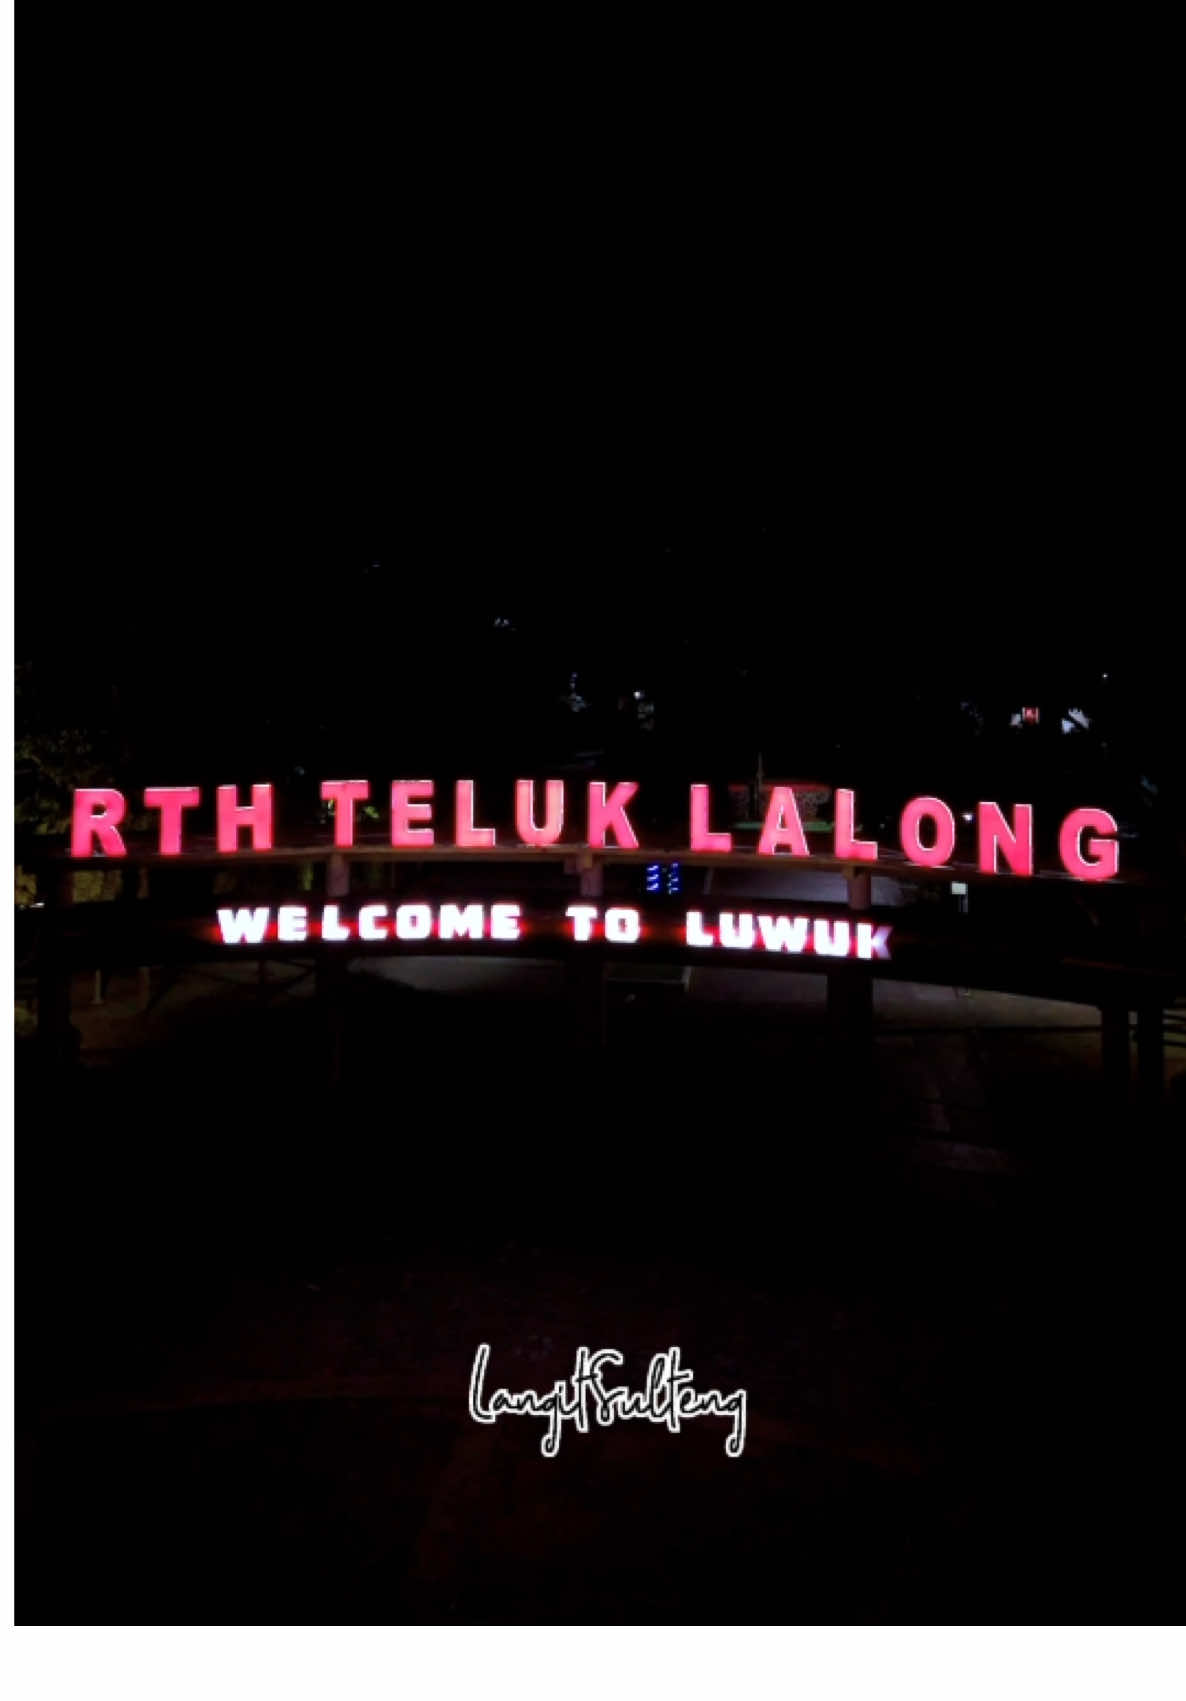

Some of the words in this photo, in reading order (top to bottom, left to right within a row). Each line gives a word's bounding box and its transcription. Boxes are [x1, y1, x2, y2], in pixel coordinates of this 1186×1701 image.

[71, 784, 273, 858] RTH
[321, 779, 640, 849] TELUK
[690, 784, 1120, 881] LALONG
[218, 904, 521, 943] WELCOME
[566, 906, 641, 942] TO
[686, 911, 893, 958] LUWUK
